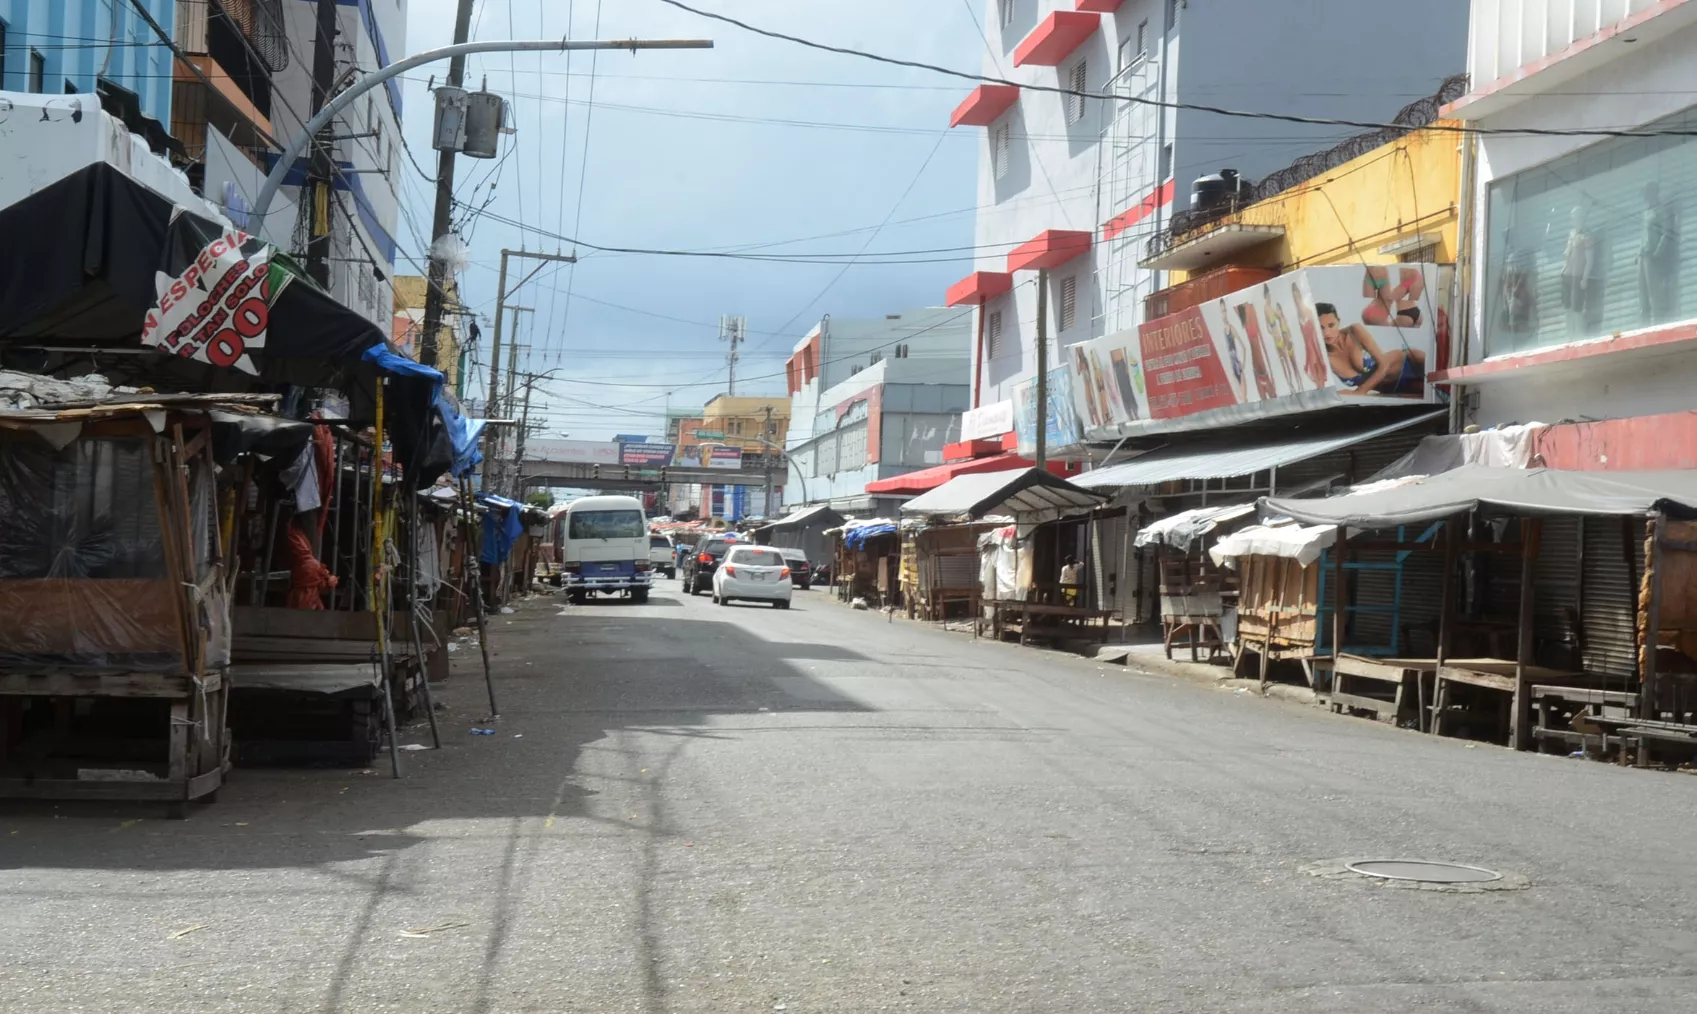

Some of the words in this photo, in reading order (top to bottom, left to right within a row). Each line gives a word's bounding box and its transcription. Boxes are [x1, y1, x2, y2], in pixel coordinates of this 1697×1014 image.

[191, 306, 229, 344] TAN
[225, 263, 270, 310] SOLO
[1142, 316, 1204, 354] INTERIORES
